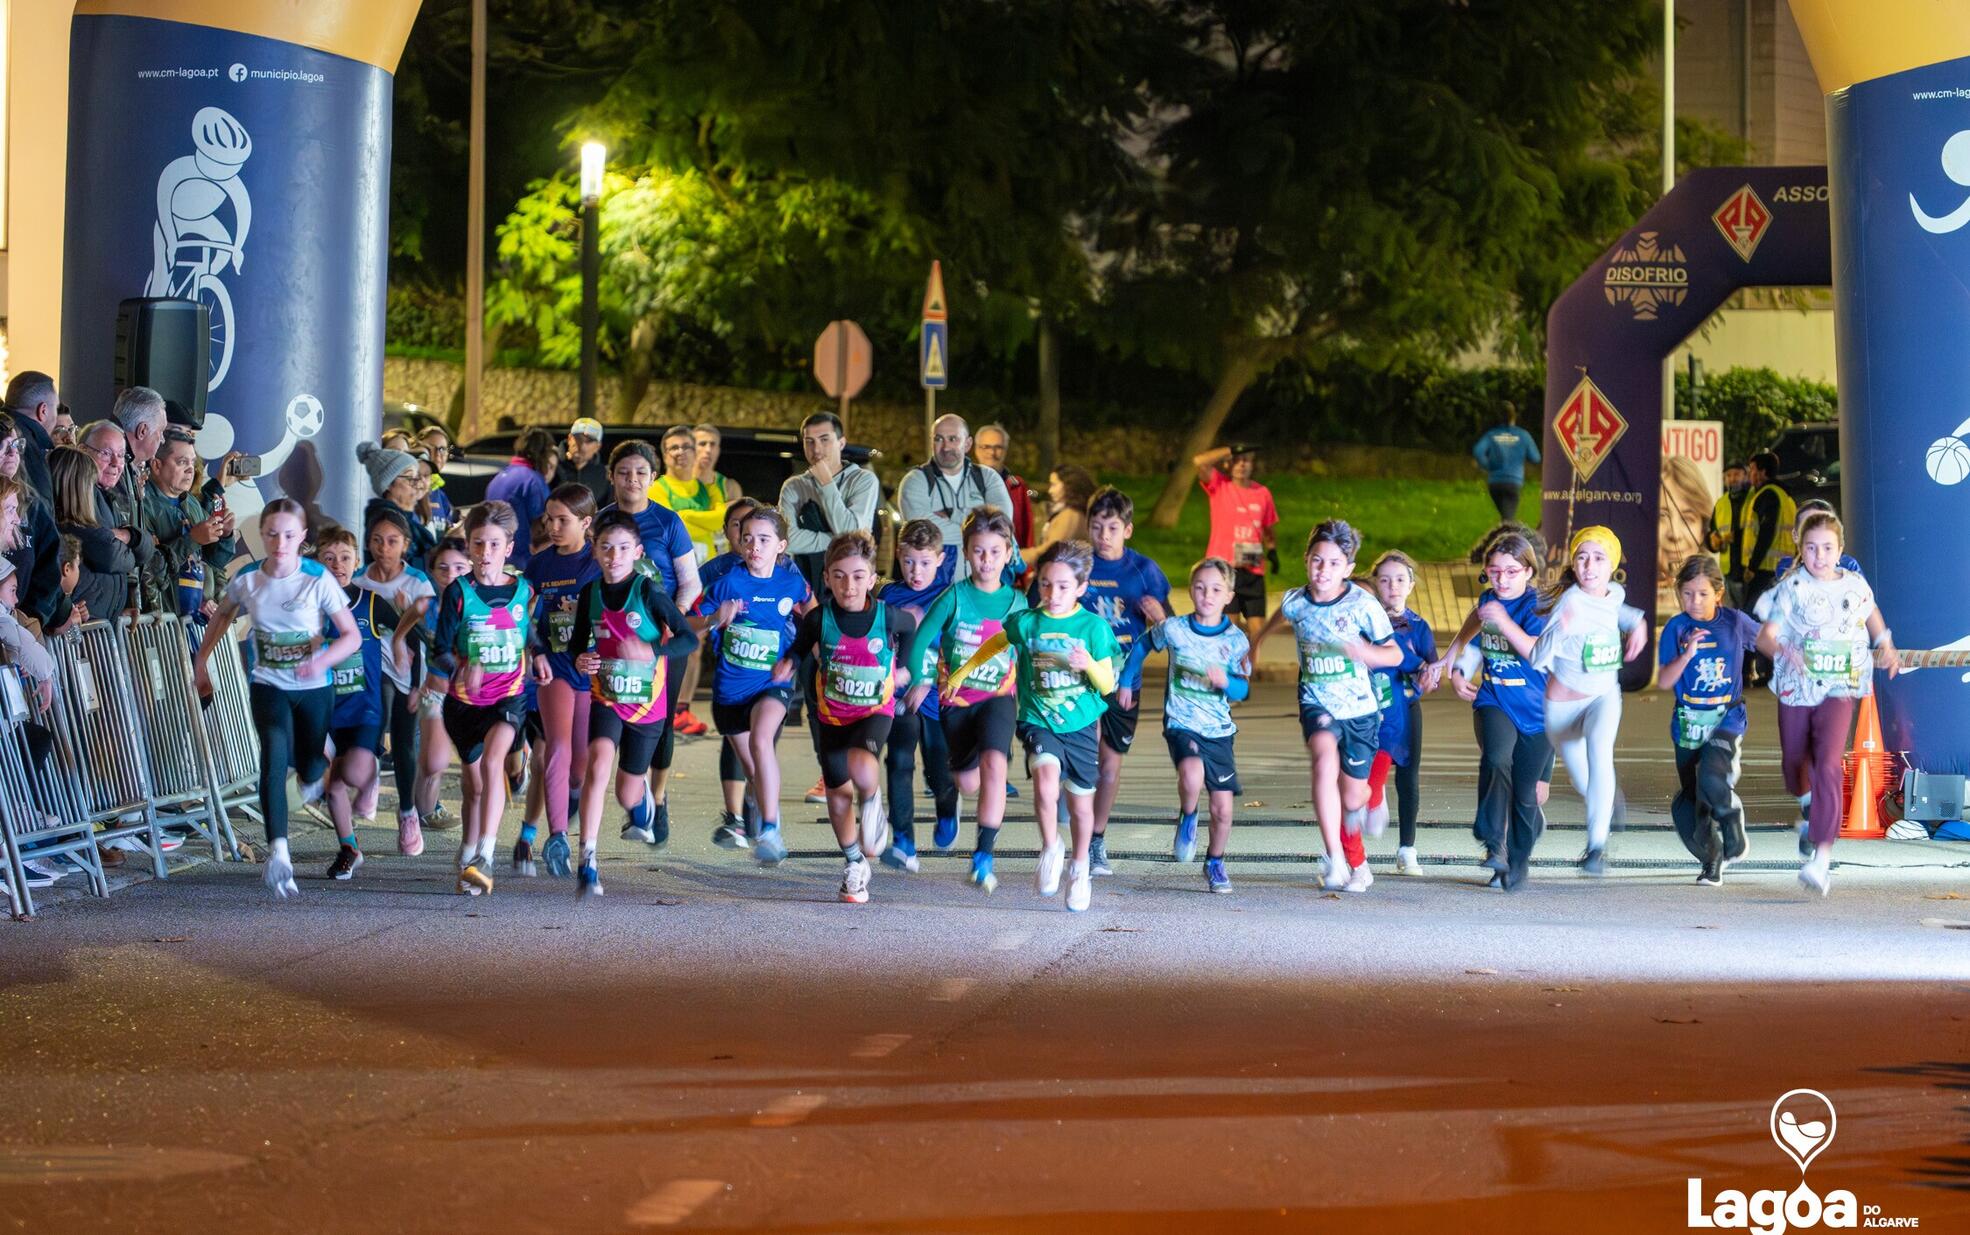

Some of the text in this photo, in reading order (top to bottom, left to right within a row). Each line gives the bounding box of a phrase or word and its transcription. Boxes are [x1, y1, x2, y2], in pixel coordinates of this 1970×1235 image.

[138, 67, 219, 80] www.cm-lagoa.pt
[1606, 266, 1688, 282] DISOFRIO
[730, 638, 771, 661] 3002
[1307, 655, 1346, 675] 3006
[1814, 654, 1846, 672] 3012
[607, 674, 643, 694] 3015
[835, 676, 876, 697] 3020
